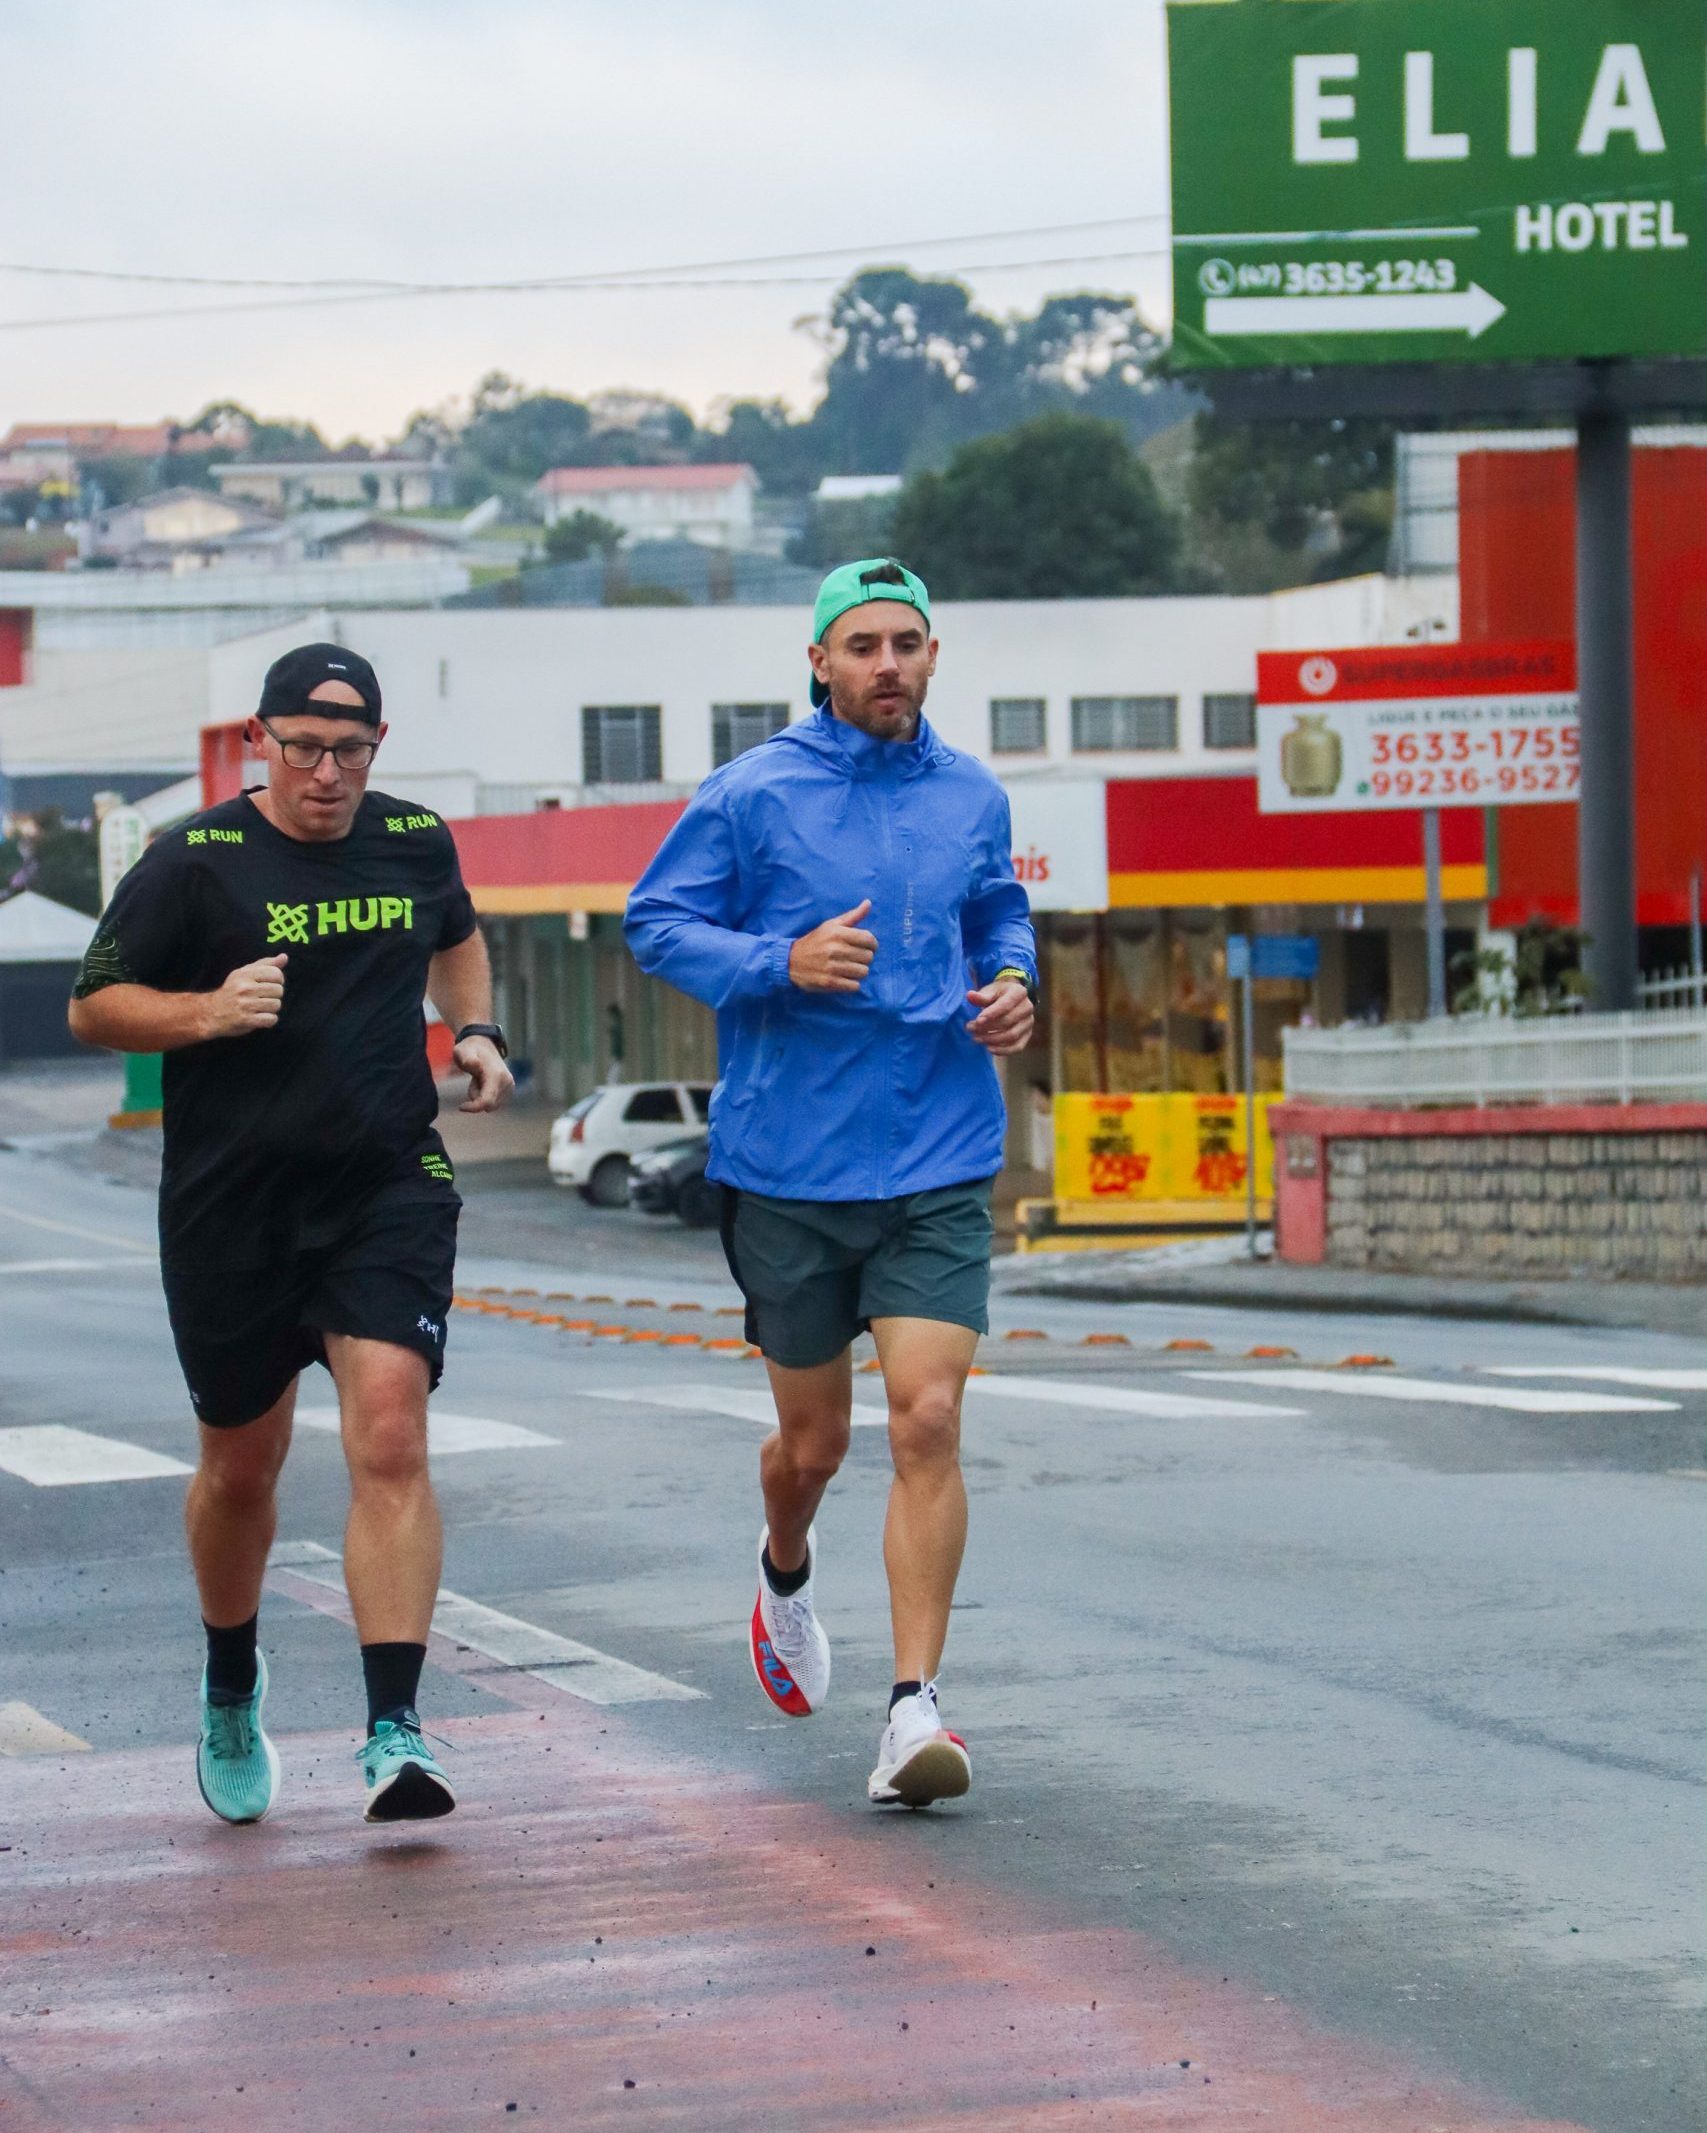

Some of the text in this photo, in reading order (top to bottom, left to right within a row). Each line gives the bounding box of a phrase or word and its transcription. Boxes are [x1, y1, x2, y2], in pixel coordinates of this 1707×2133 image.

[1292, 43, 1707, 165] ELIA
[1515, 201, 1689, 253] HOTEL
[1283, 258, 1456, 295] 3635-1243
[1371, 726, 1582, 765] 3633-1755
[1371, 763, 1582, 796] 99236-9527
[210, 829, 243, 844] RUN
[407, 814, 438, 830] RUN
[317, 897, 413, 936] HUPI
[758, 1641, 794, 1697] FILA
